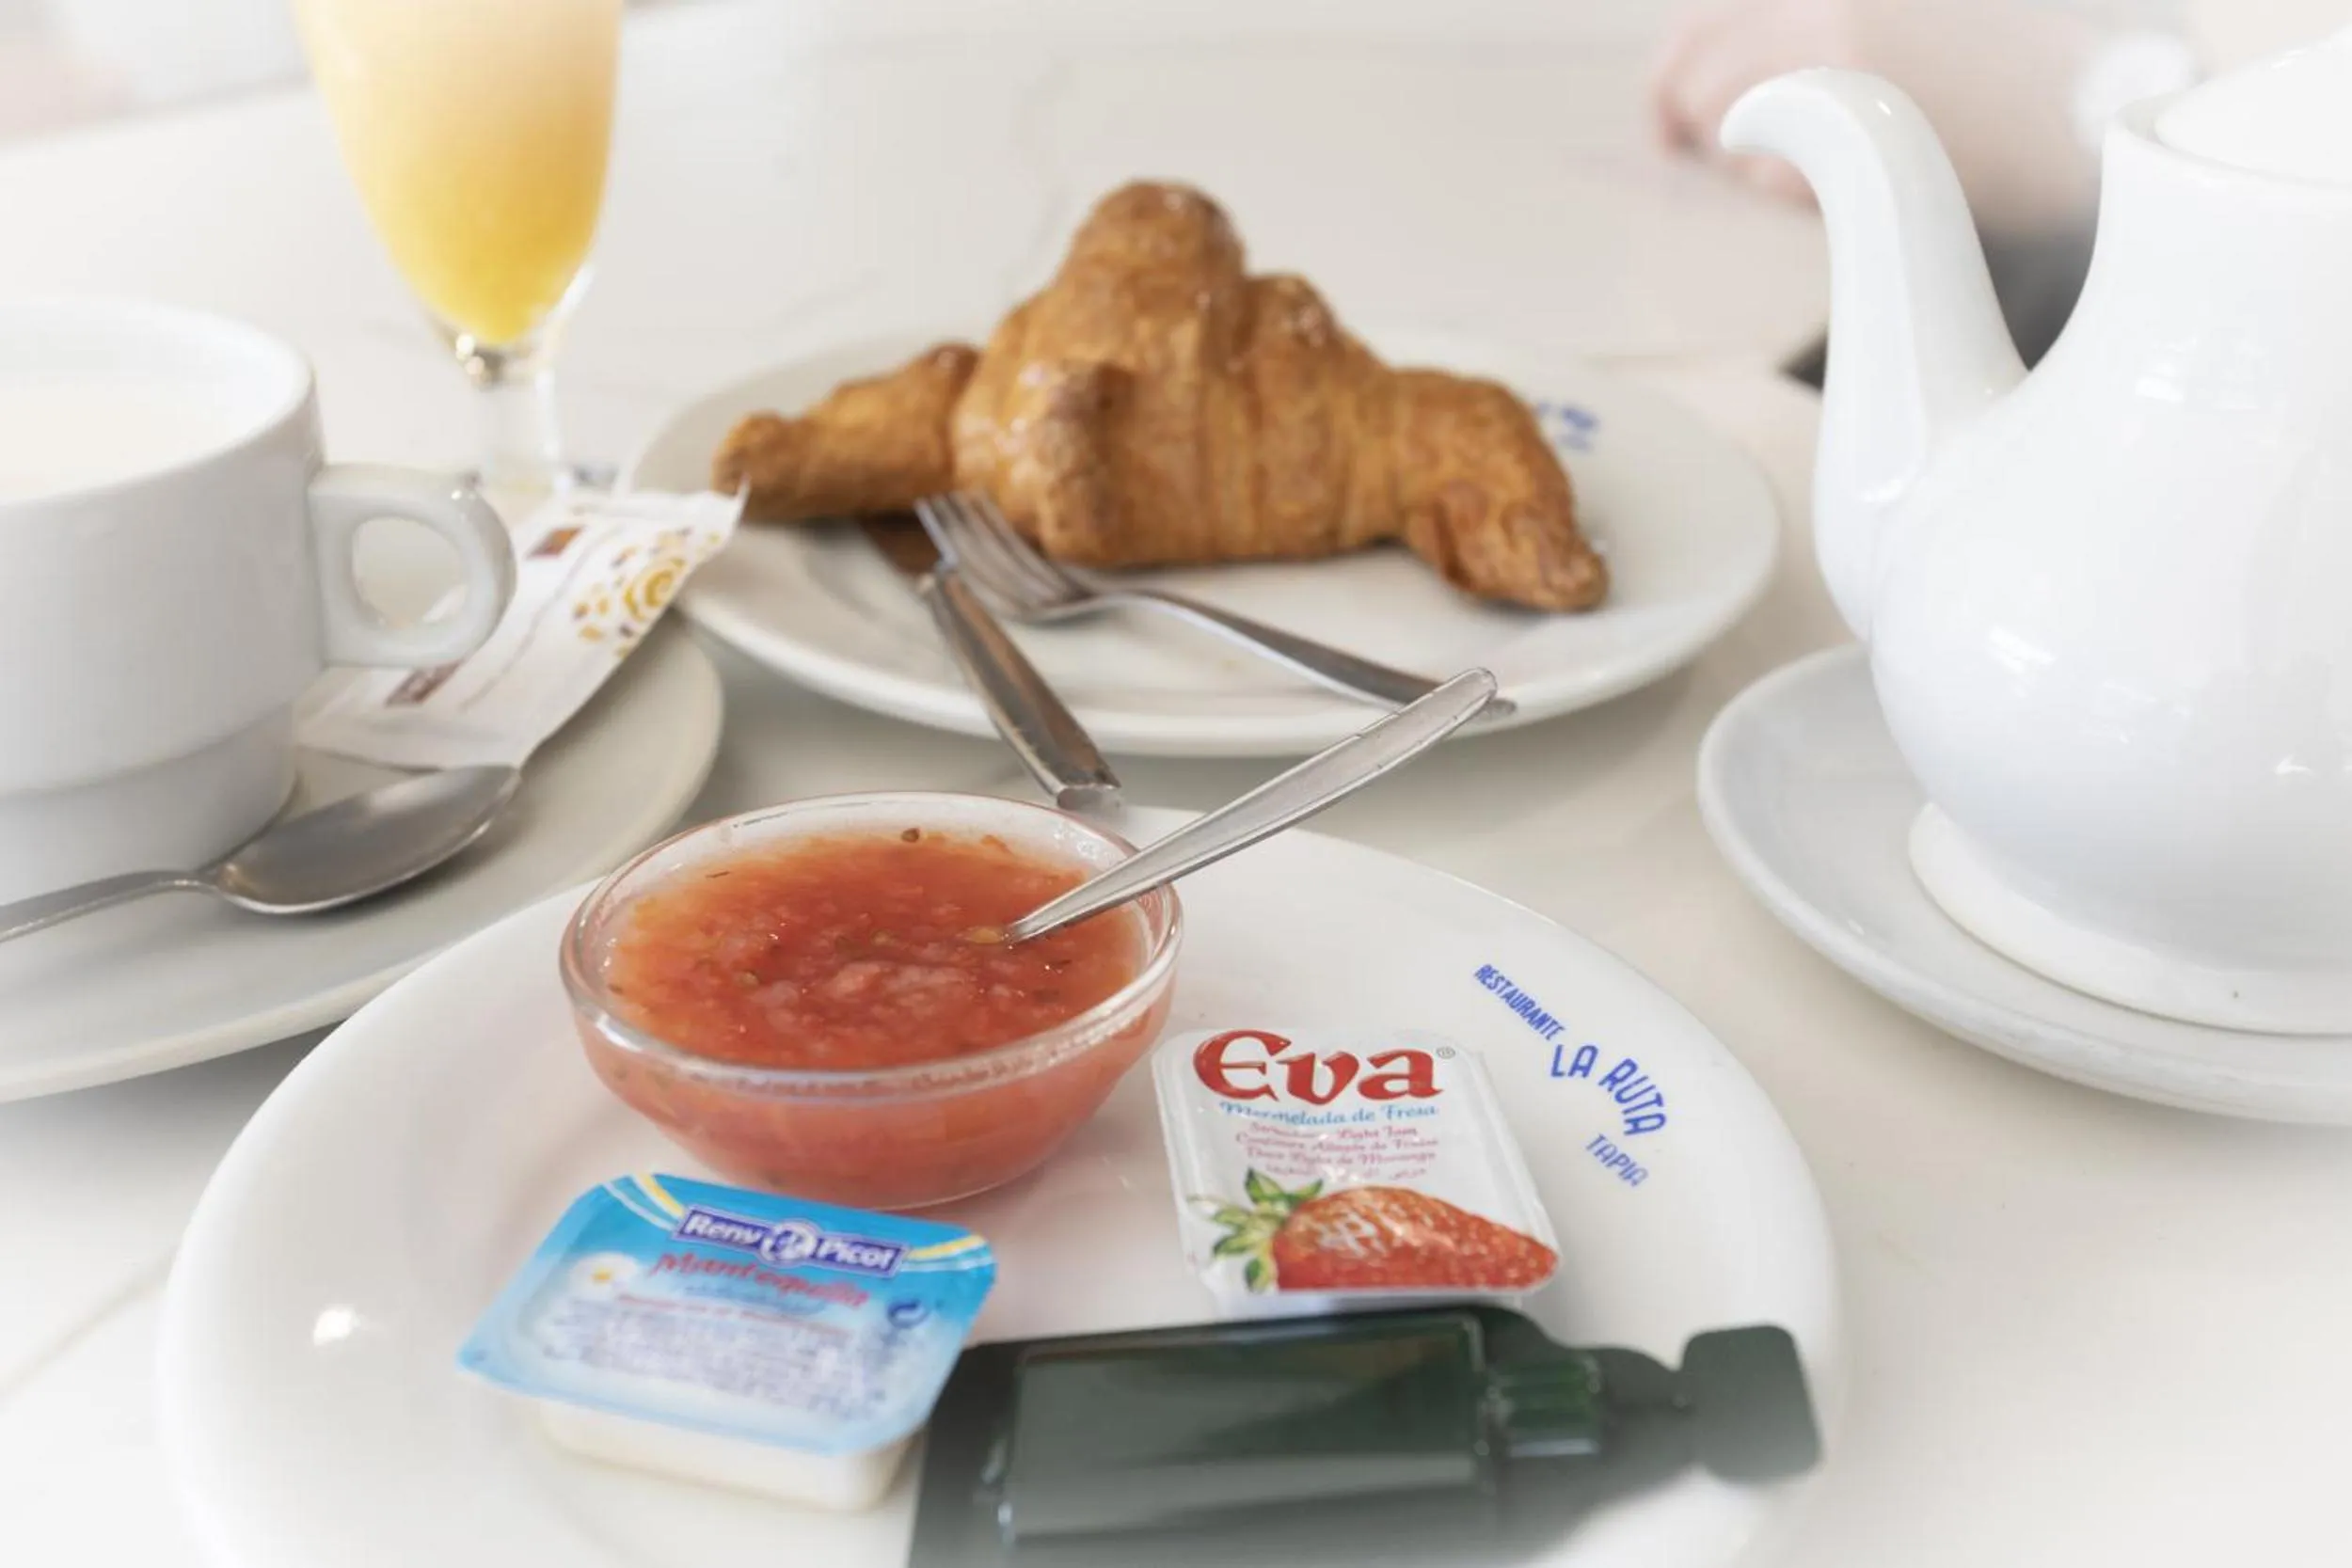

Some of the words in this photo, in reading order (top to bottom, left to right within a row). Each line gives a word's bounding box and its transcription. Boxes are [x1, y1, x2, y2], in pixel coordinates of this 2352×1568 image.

[1473, 964, 1565, 1041] RESTAURANTE
[1193, 1029, 1445, 1105] Eva
[1550, 1044, 1599, 1078] LA
[1597, 1058, 1667, 1136] RUTA
[1352, 1108, 1376, 1123] de
[1585, 1133, 1648, 1187] TAPIA
[685, 1212, 764, 1245] Reny
